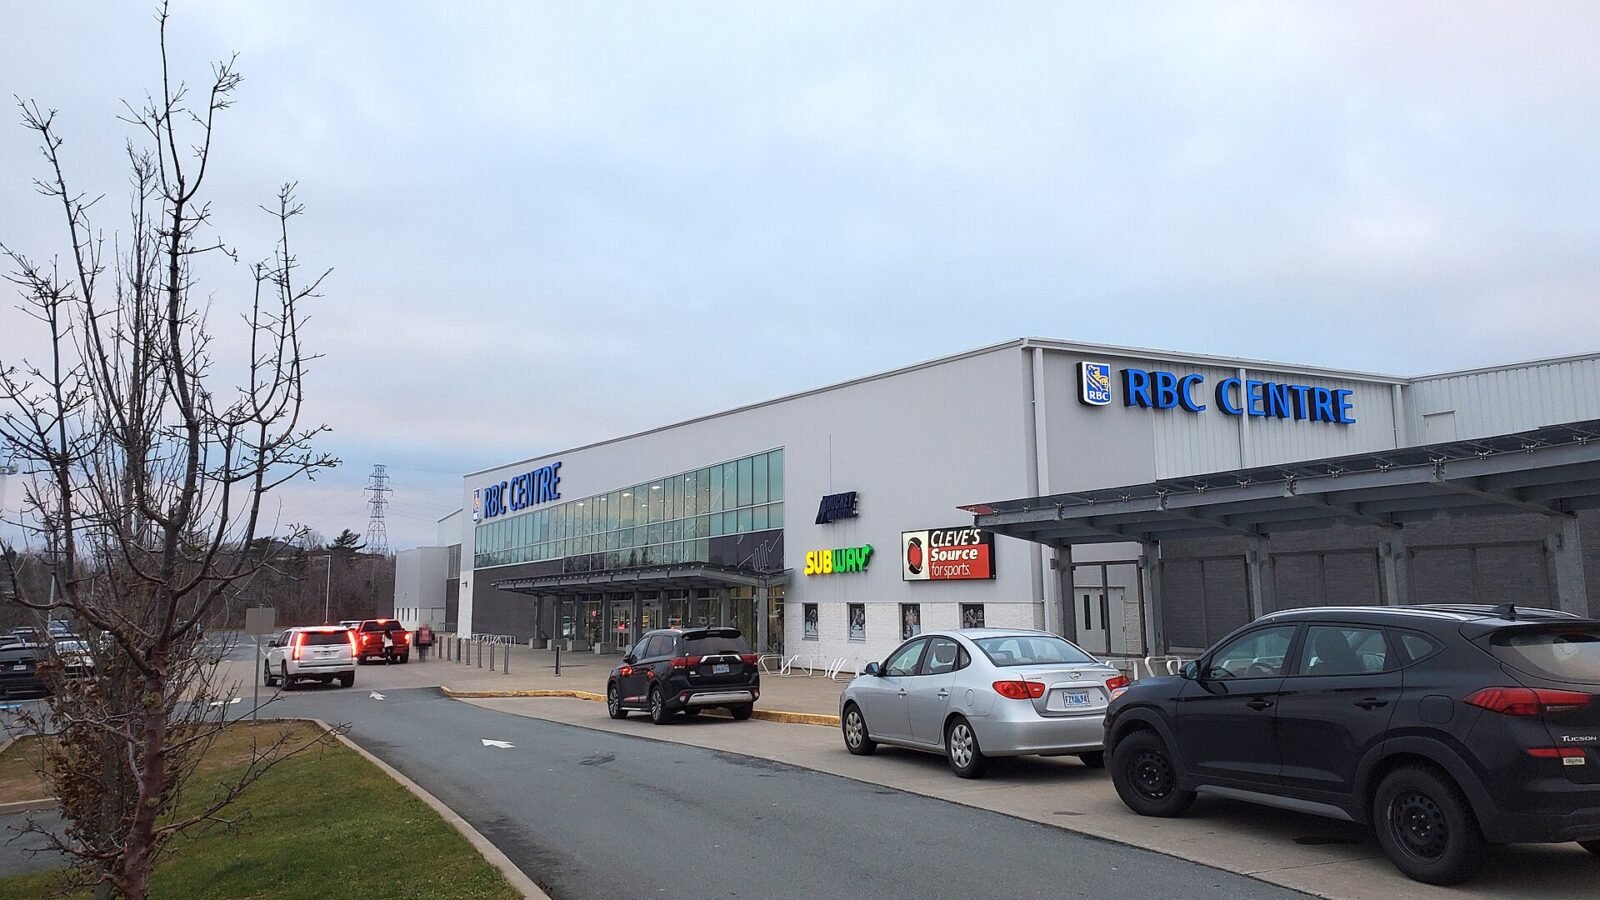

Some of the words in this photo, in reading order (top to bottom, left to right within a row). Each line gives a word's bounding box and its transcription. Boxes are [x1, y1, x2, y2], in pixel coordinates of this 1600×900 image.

[1089, 390, 1109, 400] RBC
[1121, 368, 1206, 412] RBC
[1215, 377, 1356, 424] CENTRE
[484, 481, 507, 518] RBC
[509, 461, 562, 511] CENTRE
[930, 528, 981, 547] CLEVE'S
[804, 544, 874, 575] SUBWAY
[931, 547, 978, 562] Source
